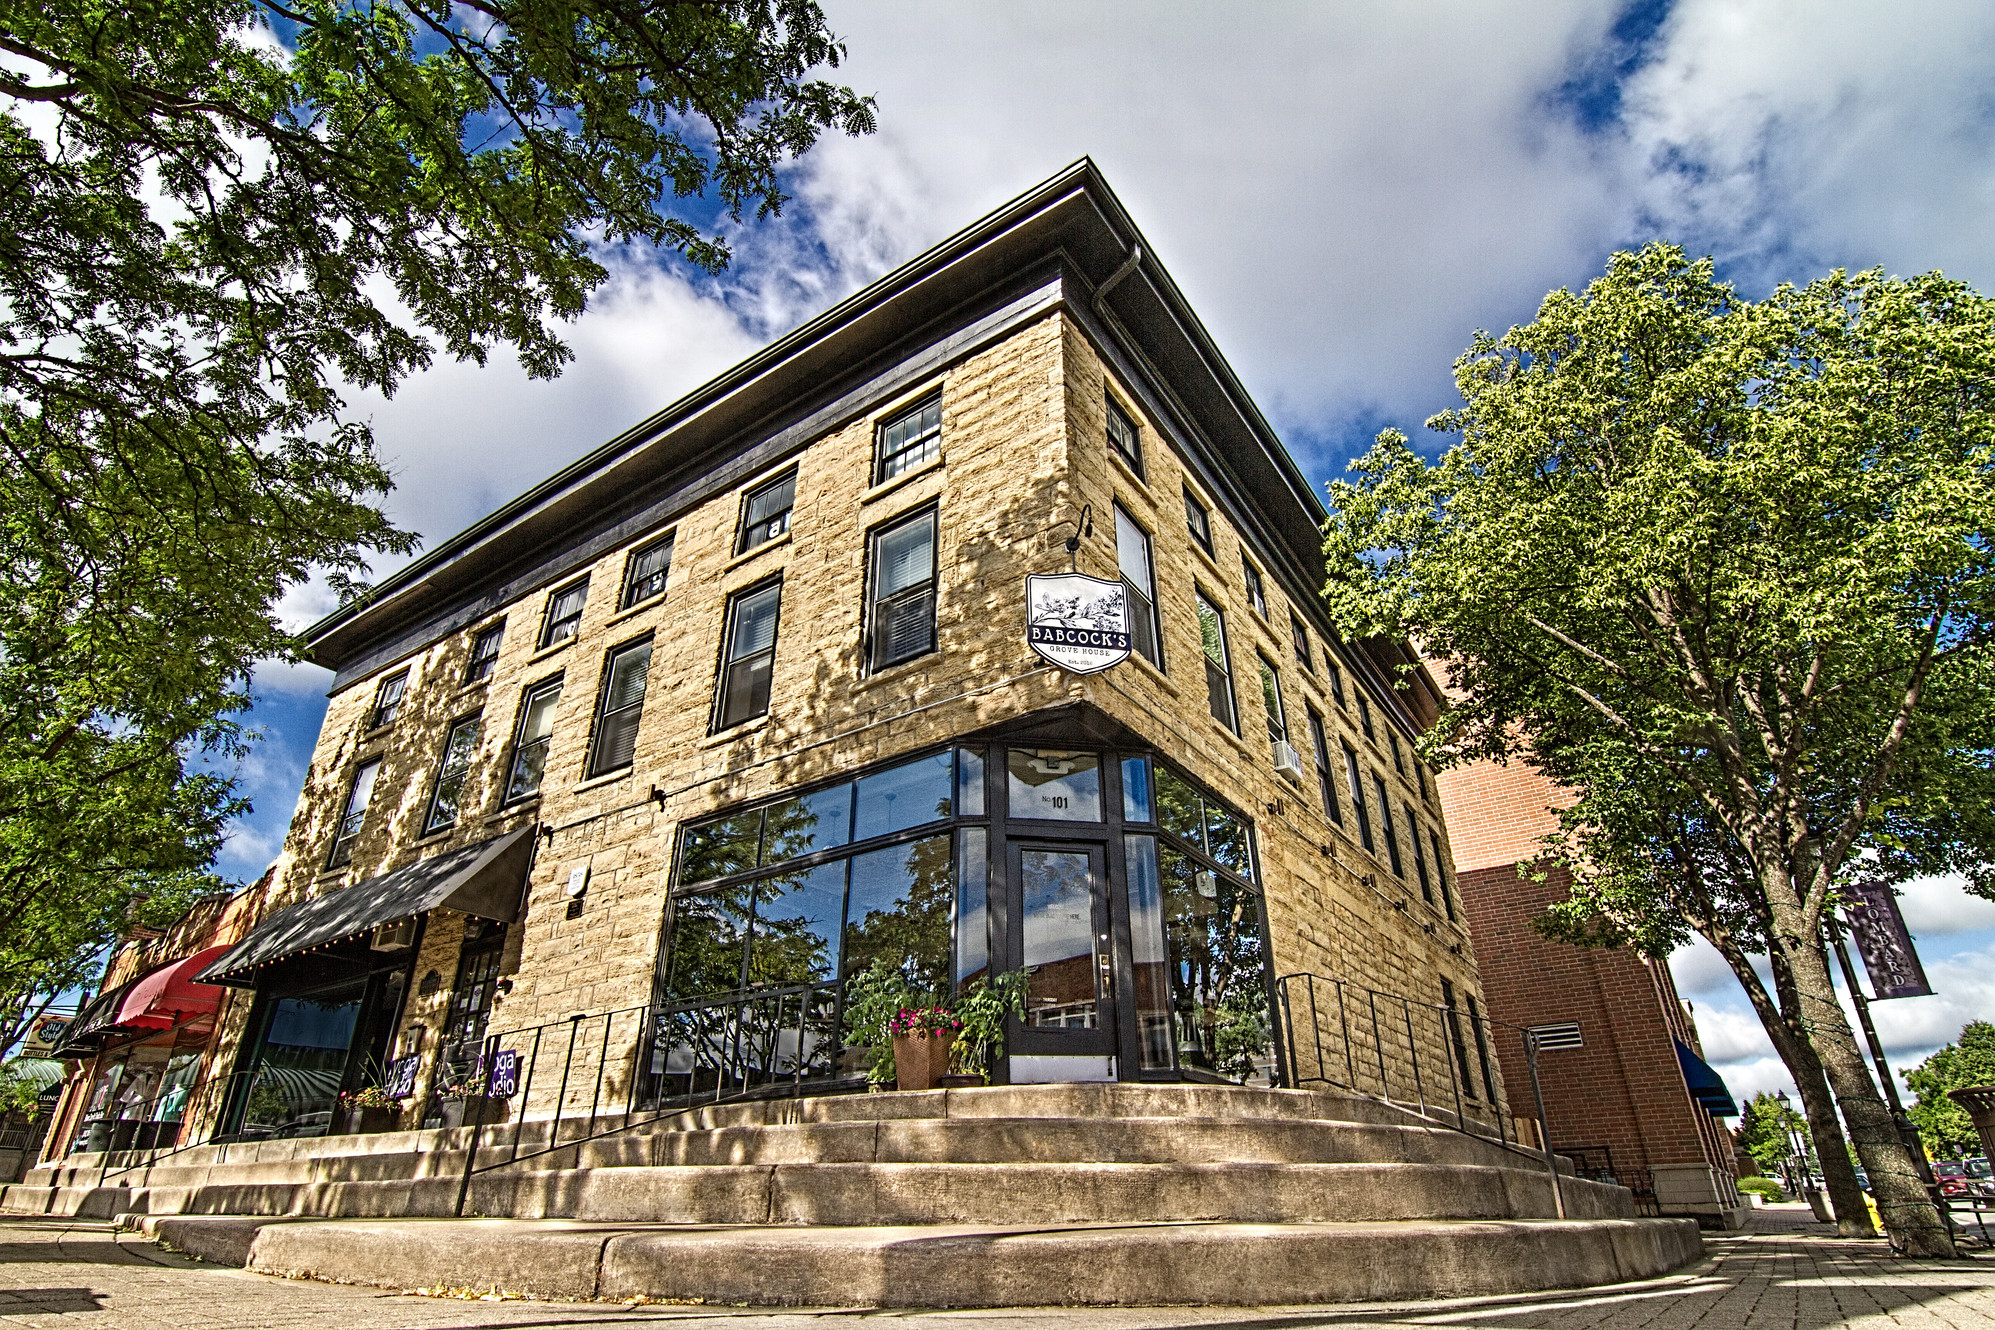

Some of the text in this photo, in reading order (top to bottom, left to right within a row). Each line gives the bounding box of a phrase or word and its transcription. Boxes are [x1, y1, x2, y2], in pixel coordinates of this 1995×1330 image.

[1031, 627, 1127, 648] BABCOCK'S
[1049, 645, 1110, 657] GROVE HOUSE
[1052, 796, 1068, 809] 101
[1863, 896, 1905, 986] LOMBARD
[46, 1023, 60, 1031] Old
